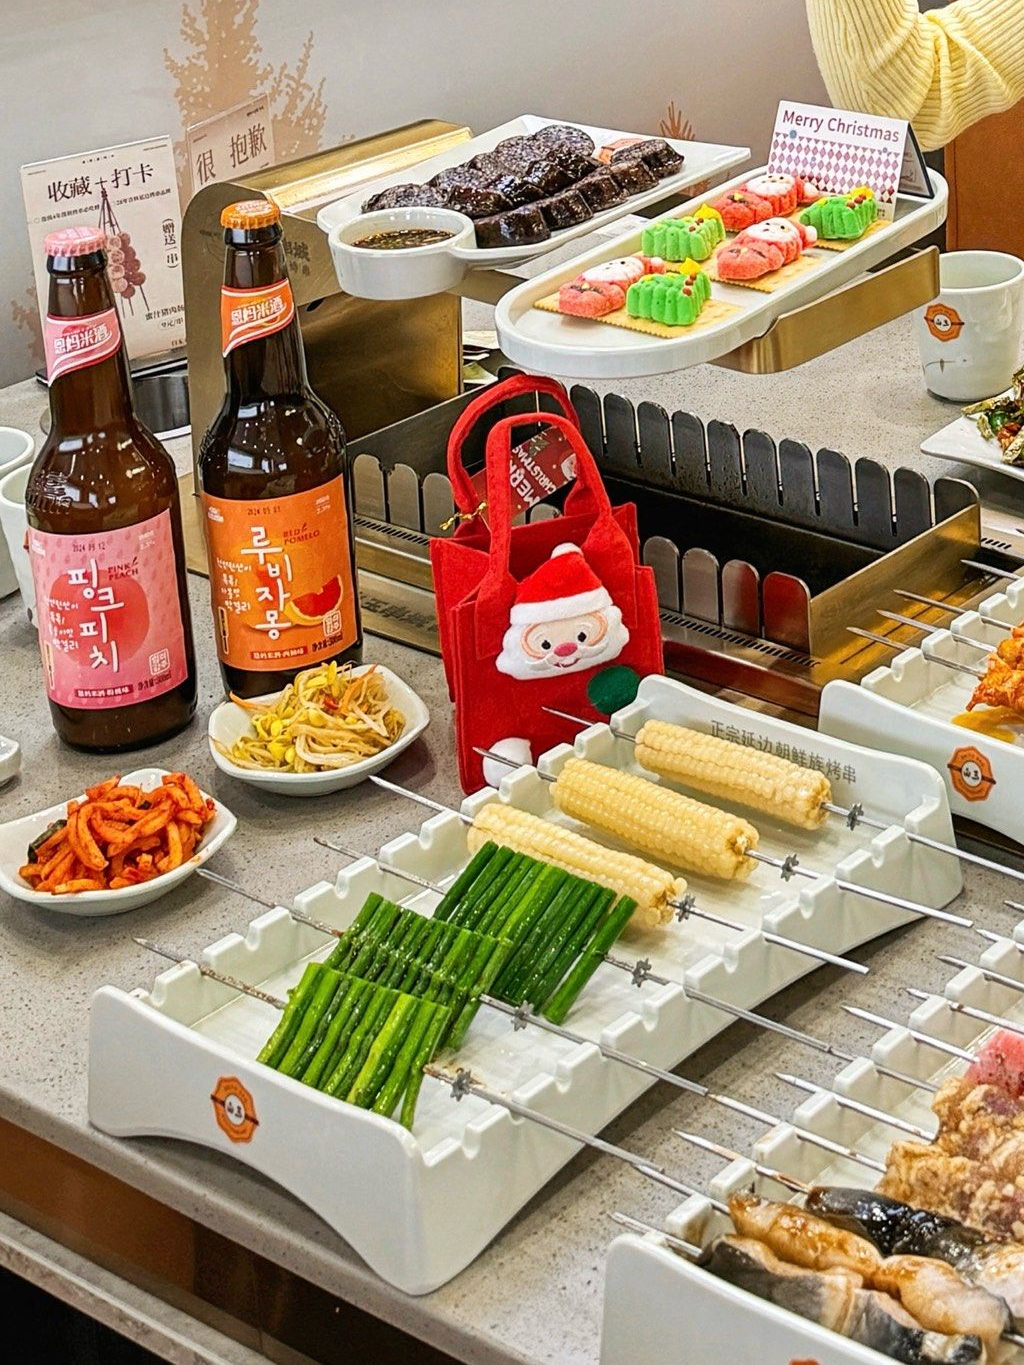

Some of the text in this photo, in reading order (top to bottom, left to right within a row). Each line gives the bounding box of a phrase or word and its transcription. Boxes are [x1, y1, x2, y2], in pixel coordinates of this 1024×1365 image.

[783, 110, 900, 143] Merry Christmas
[196, 123, 268, 185] 很 抱歉
[231, 296, 286, 326] 恩妈米酒
[54, 325, 112, 355] 恩妈米酒
[512, 445, 557, 494] CHRISTMAS
[107, 561, 131, 575] PINK
[108, 567, 139, 582] PEACH
[241, 526, 292, 640] 루비자몽
[710, 720, 857, 785] 正宗延边朝鲜族烤串
